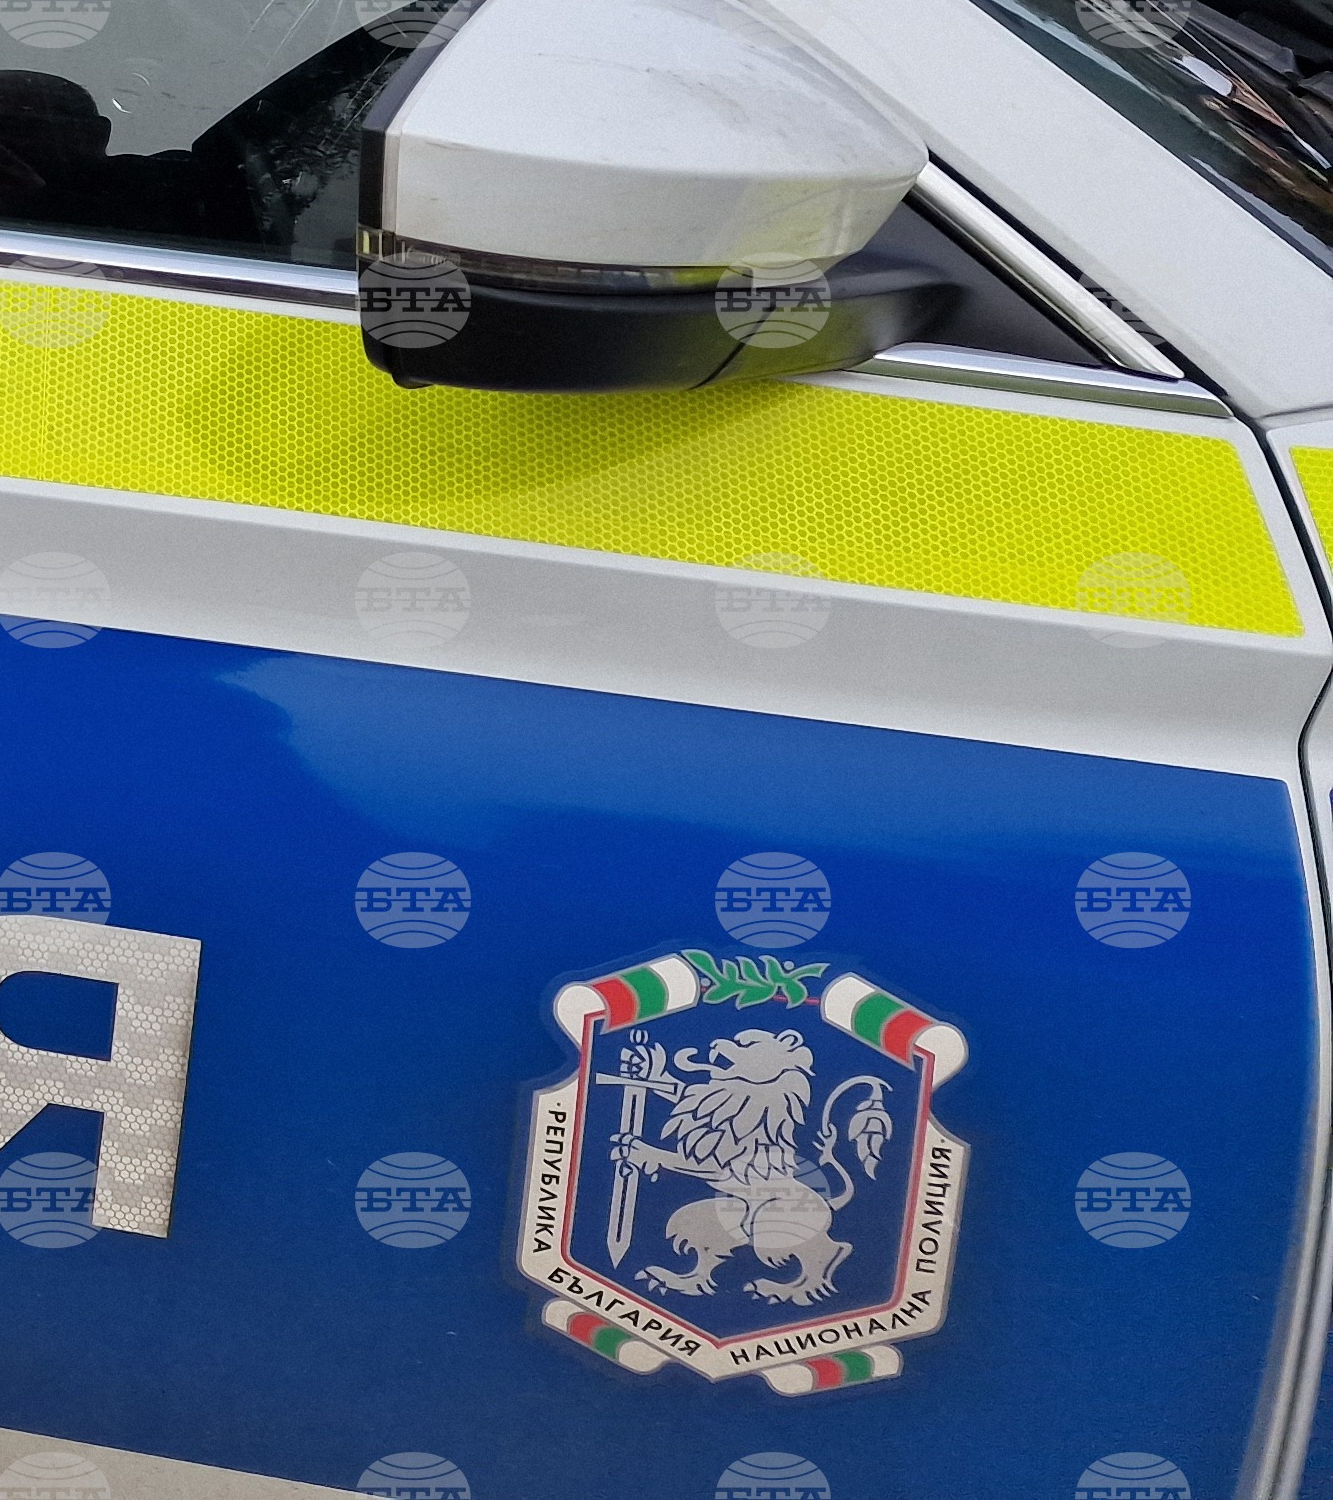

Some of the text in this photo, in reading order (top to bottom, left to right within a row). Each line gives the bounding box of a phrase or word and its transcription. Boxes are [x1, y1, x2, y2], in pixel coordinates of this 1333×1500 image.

[532, 1108, 702, 1357] РЕПУБЛИКА БЪЛГАРИЯ
[729, 1288, 932, 1366] НАЦИОНАЛНА
[915, 1146, 953, 1274] ПОЛИЦИЯ
